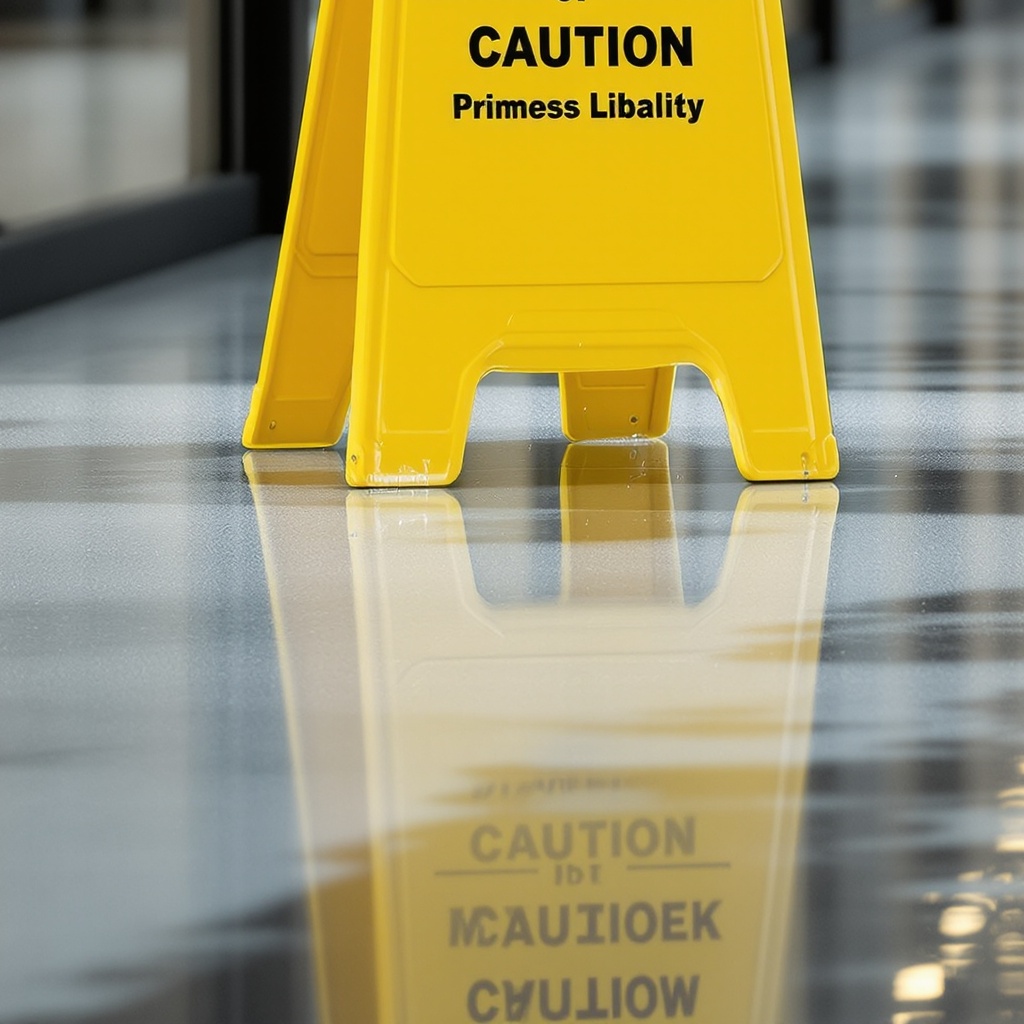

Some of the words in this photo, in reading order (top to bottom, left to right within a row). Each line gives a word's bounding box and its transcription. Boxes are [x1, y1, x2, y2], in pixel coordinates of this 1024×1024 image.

[469, 25, 693, 68] CAUTION
[590, 92, 705, 124] Libality
[470, 817, 696, 863] CAUTION
